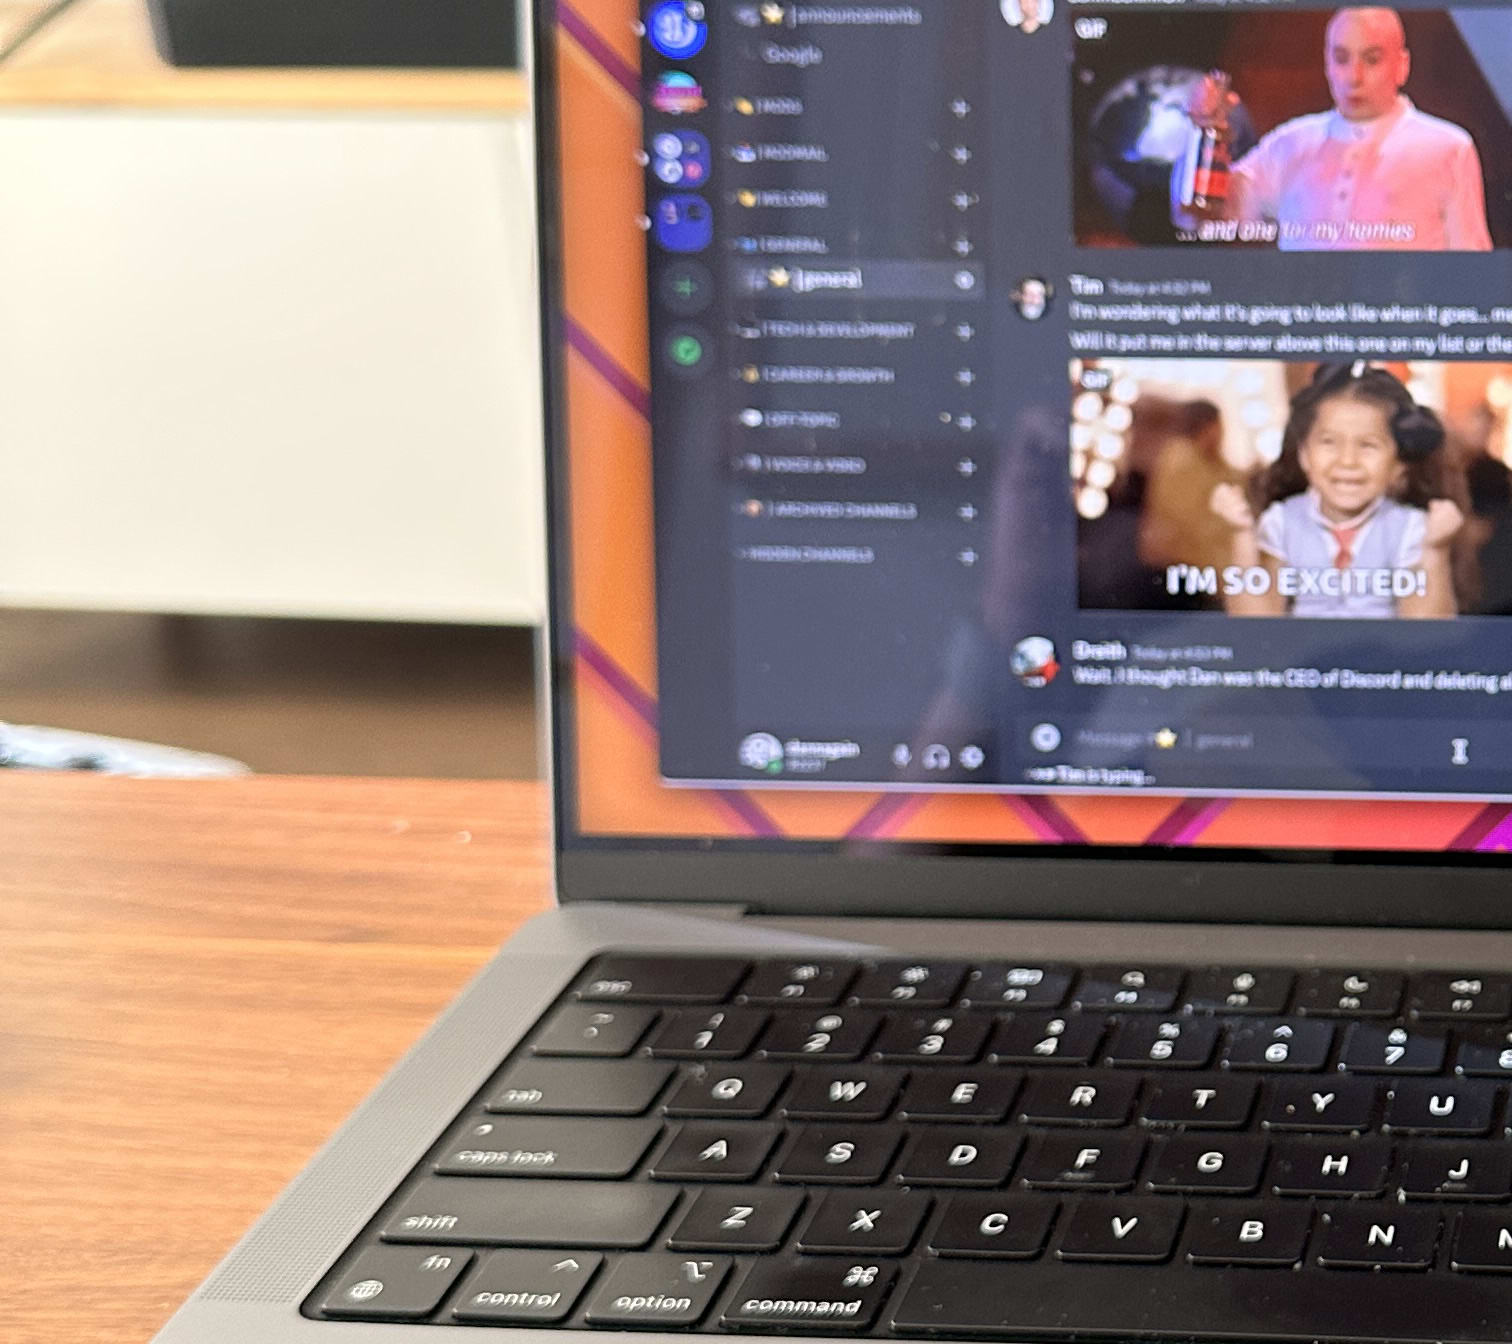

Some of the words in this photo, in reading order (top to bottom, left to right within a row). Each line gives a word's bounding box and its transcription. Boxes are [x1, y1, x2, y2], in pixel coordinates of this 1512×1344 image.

[761, 42, 823, 66] Google
[1239, 220, 1278, 242] one
[1314, 221, 1344, 244] my
[1069, 273, 1103, 295] Tim
[1069, 301, 1097, 321] I'm
[1098, 302, 1182, 326] wondering
[1182, 302, 1221, 323] what
[1224, 302, 1249, 323] it's
[1249, 304, 1293, 326] going
[1294, 303, 1312, 323] to
[1312, 301, 1348, 323] look
[1349, 301, 1379, 323] like
[1380, 302, 1421, 323] when
[1422, 302, 1438, 323] it
[1068, 330, 1103, 353] Will
[1104, 331, 1118, 352] it
[1118, 332, 1149, 355] put
[1150, 333, 1176, 353] me
[1176, 332, 1192, 352] in
[1192, 331, 1220, 353] the
[1221, 334, 1273, 353] server
[1274, 332, 1323, 354] above
[1323, 331, 1356, 353] this
[1357, 334, 1388, 354] one
[1388, 334, 1410, 354] on
[1411, 334, 1436, 356] my
[1437, 332, 1464, 354] list
[1465, 335, 1485, 355] or
[1166, 565, 1218, 595] I'M
[1223, 566, 1270, 596] SO
[1277, 566, 1427, 597] EXCITED!
[1125, 666, 1187, 688] thought
[1187, 666, 1222, 687] Dan
[1223, 670, 1255, 688] was
[1255, 668, 1284, 688] the
[1284, 668, 1320, 688] CEO
[1320, 668, 1339, 688] of
[1339, 668, 1402, 689] Discord
[1402, 670, 1434, 690] and
[1434, 670, 1499, 695] deleting
[1056, 764, 1085, 783] Tim
[804, 1032, 830, 1053] 2
[919, 1034, 944, 1054] 3
[1034, 1036, 1058, 1056] 4
[1150, 1040, 1174, 1059] 5
[1265, 1043, 1288, 1062] 6
[1384, 1046, 1405, 1065] 7
[712, 1077, 744, 1100] Q
[829, 1080, 867, 1101] W
[951, 1082, 978, 1104] E
[1070, 1085, 1096, 1107] R
[1193, 1088, 1216, 1109] T
[1312, 1092, 1335, 1113] Y
[1429, 1095, 1454, 1116] U
[458, 1149, 507, 1165] caps
[511, 1149, 559, 1164] lock
[698, 1139, 728, 1162] A
[825, 1142, 854, 1164] S
[948, 1144, 978, 1166] D
[1075, 1148, 1100, 1170] F
[1198, 1151, 1223, 1173] G
[1322, 1155, 1349, 1176] H
[1448, 1158, 1469, 1181] J
[401, 1213, 458, 1231] shift
[721, 1205, 754, 1229] Z
[848, 1208, 881, 1232] X
[980, 1212, 1009, 1236] C
[1111, 1216, 1138, 1239] V
[1238, 1219, 1265, 1243] B
[1368, 1224, 1395, 1247] N
[420, 1255, 452, 1271] fn
[475, 1290, 561, 1309] control
[611, 1294, 692, 1313] option
[741, 1295, 862, 1317] command
